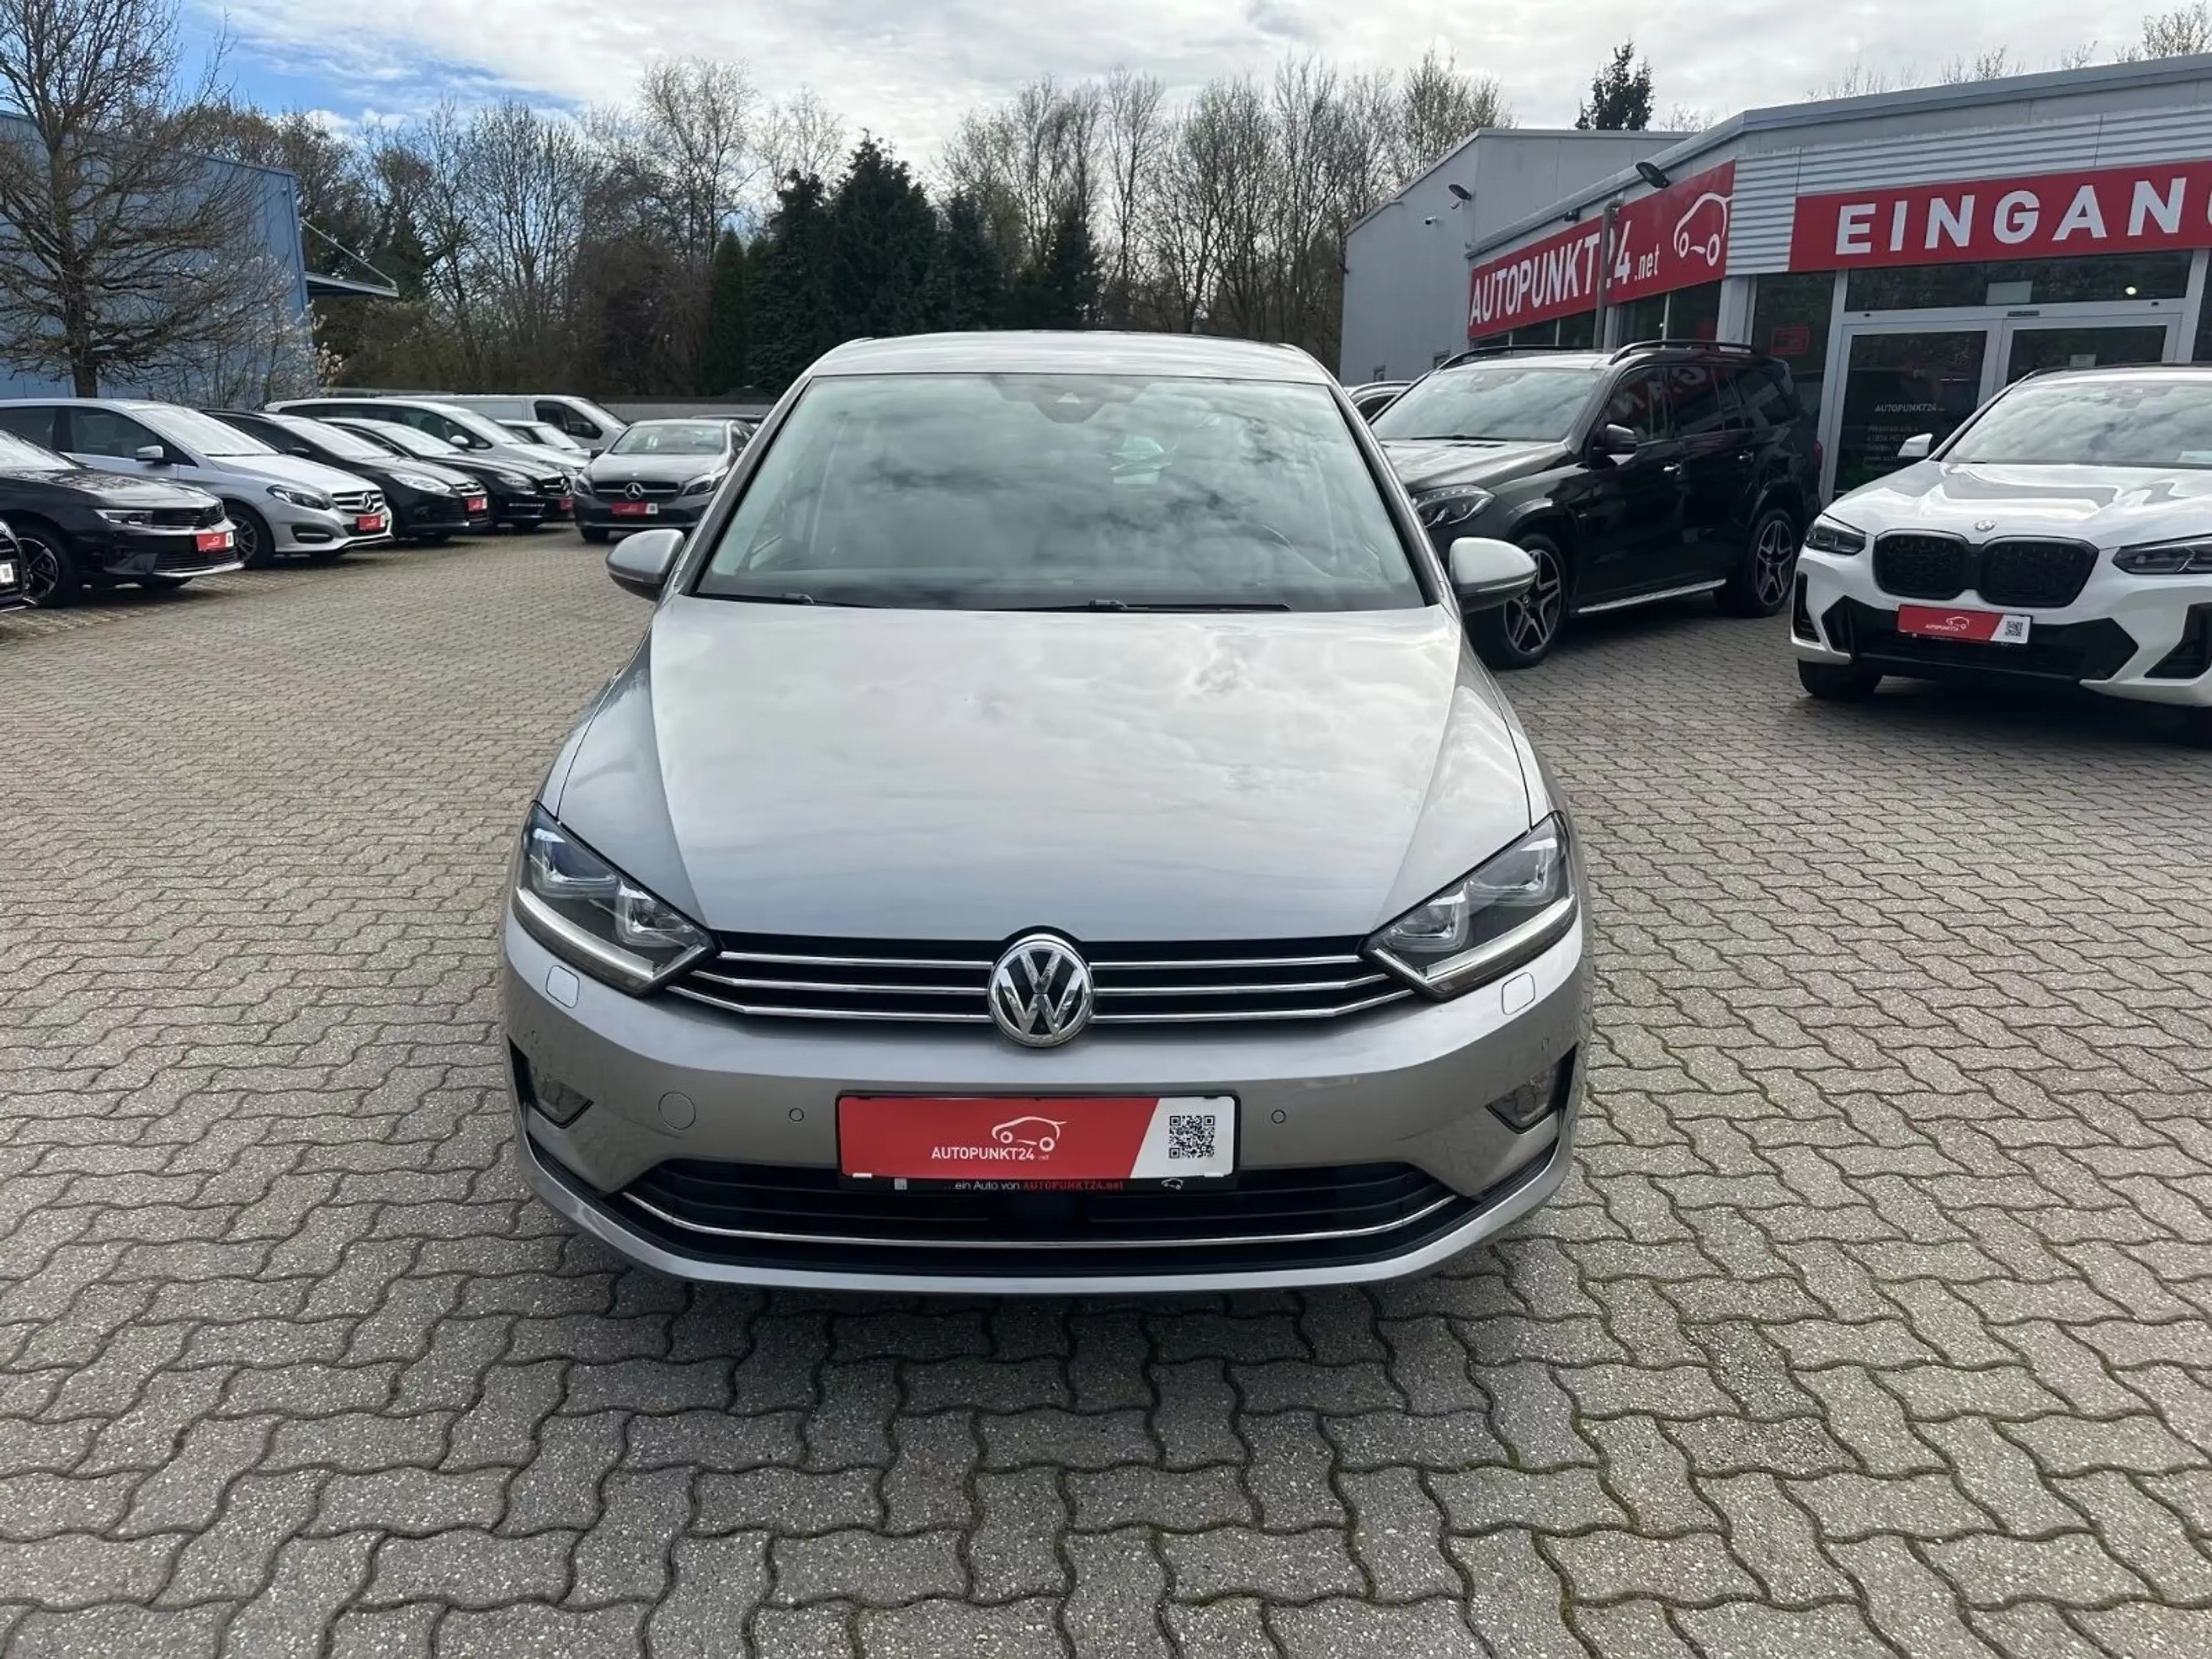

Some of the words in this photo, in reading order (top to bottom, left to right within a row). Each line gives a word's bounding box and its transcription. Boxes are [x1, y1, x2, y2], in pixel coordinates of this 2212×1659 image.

[1835, 177, 2211, 255] EINGAN
[931, 1146, 1035, 1161] AUTOPUNKT24
[973, 1181, 998, 1191] Auto
[1000, 1182, 1020, 1191] von
[1023, 1181, 1124, 1191] AUTOPUNKT24.net
